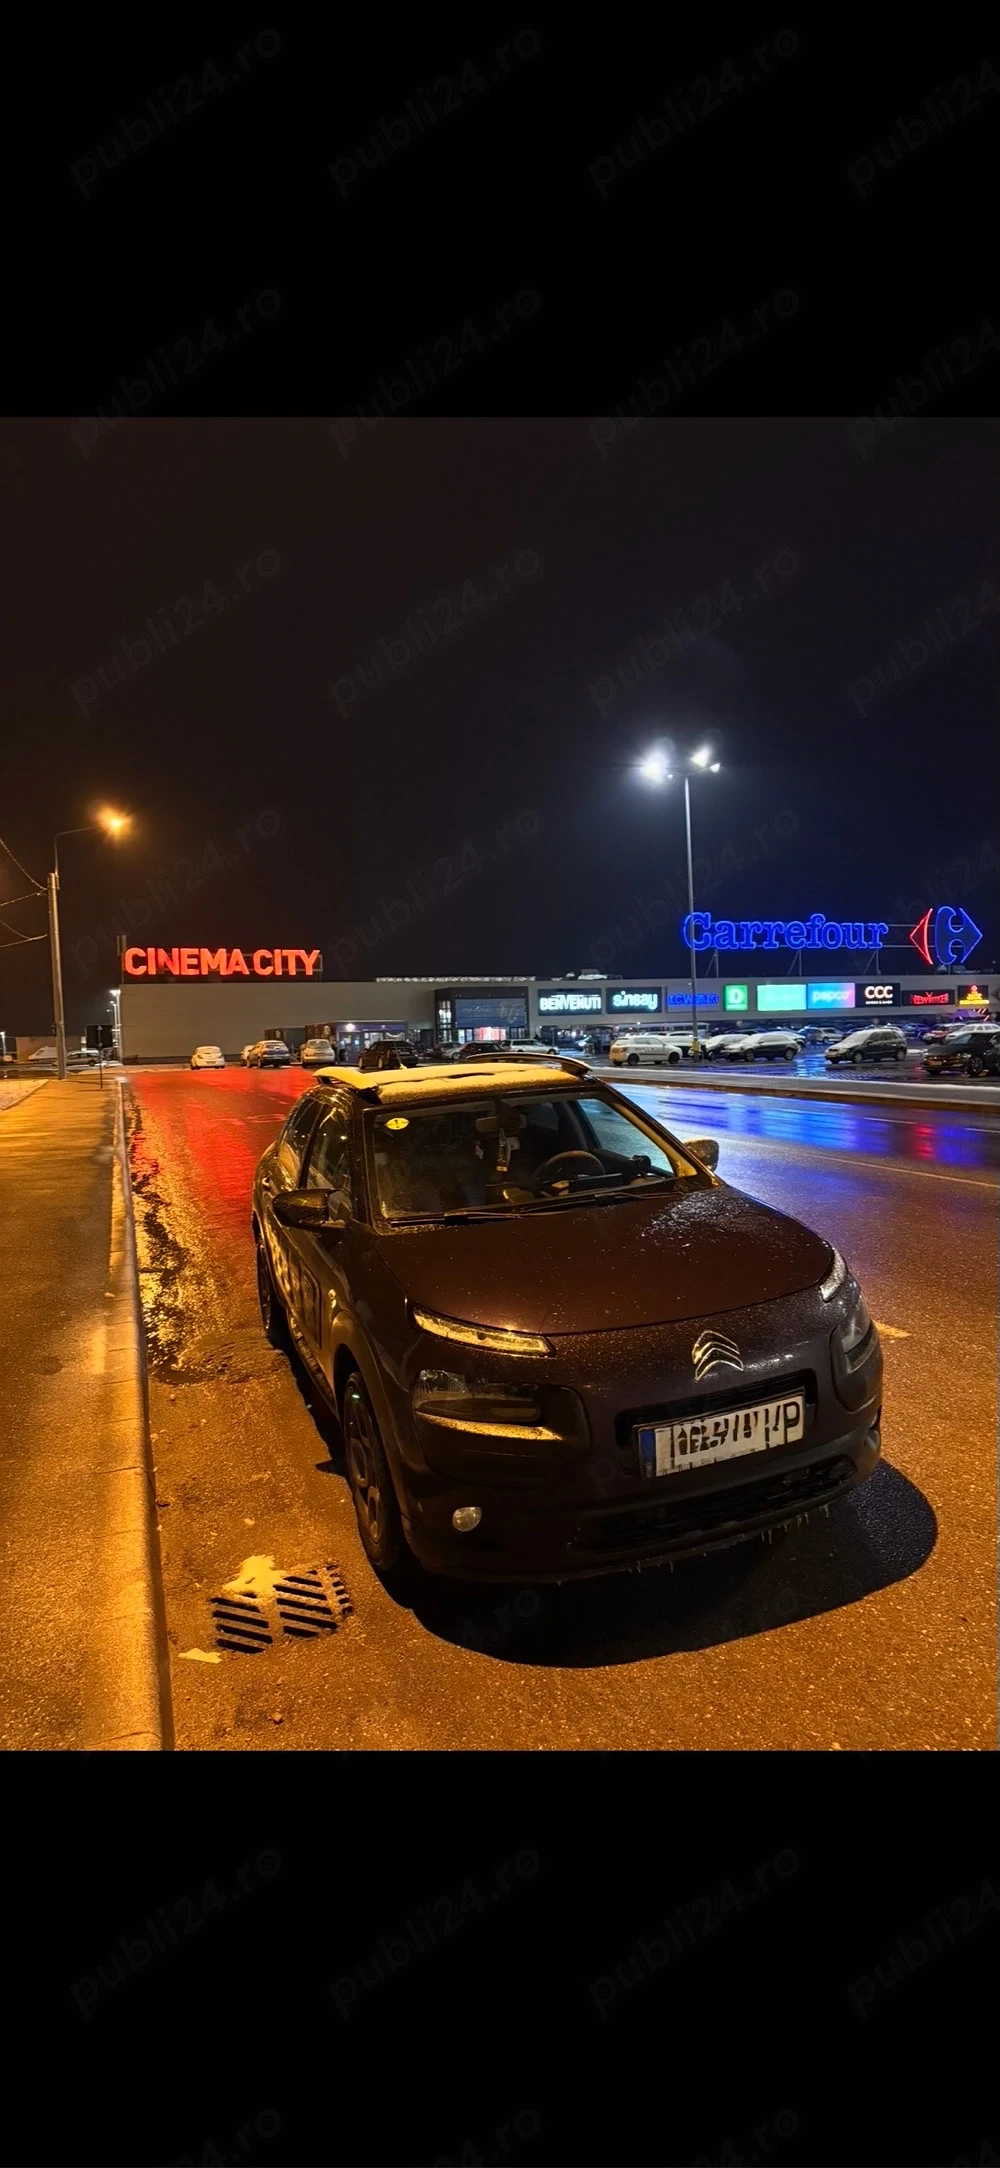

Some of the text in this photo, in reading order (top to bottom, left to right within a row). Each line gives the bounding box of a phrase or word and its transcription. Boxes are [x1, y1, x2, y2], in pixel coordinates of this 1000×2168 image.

[684, 911, 889, 951] Carrefour
[124, 947, 320, 976] CINEMA CITY
[539, 994, 601, 1010] BENVENUTI
[612, 990, 658, 1010] sinsay
[864, 985, 894, 999] CCC
